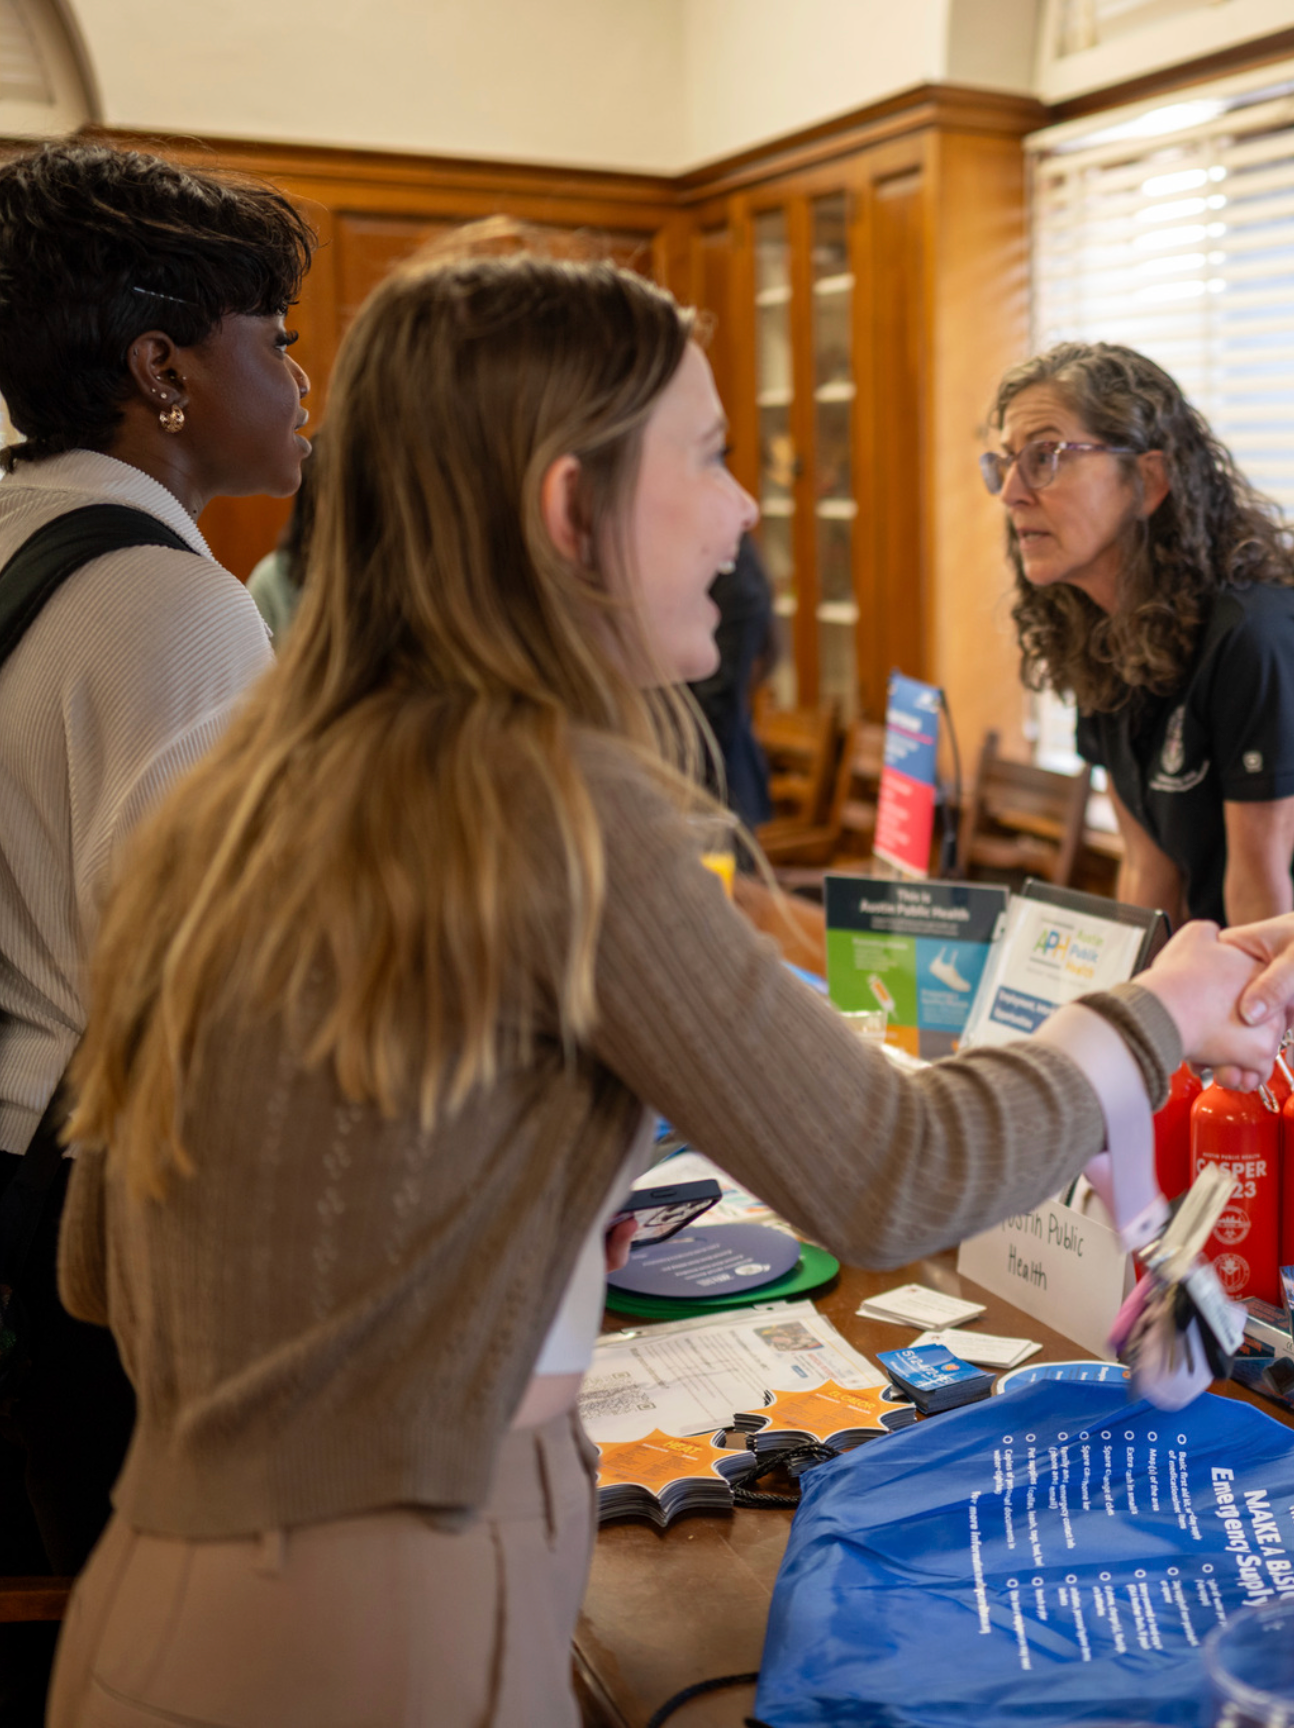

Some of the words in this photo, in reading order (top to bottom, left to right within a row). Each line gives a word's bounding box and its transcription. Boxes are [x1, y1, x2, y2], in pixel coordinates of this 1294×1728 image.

[859, 899, 896, 915] Austin
[897, 903, 930, 919] Public
[932, 907, 971, 922] Health
[1230, 1180, 1257, 1199] 23
[1001, 1213, 1044, 1240] ustin
[1047, 1212, 1085, 1258] Public
[1007, 1243, 1048, 1291] Health
[662, 1440, 703, 1455] HEAT
[1027, 1447, 1036, 1459] Pet
[1081, 1445, 1091, 1467] Spare
[1103, 1445, 1113, 1468] Spare
[1126, 1446, 1135, 1468] Extra
[1168, 1449, 1177, 1460] of
[1003, 1449, 1014, 1471] Copies
[1178, 1451, 1187, 1471] Basic
[1149, 1476, 1159, 1485] of
[1180, 1471, 1188, 1487] first
[1150, 1484, 1159, 1497] the
[969, 1505, 979, 1530] more
[1211, 1466, 1252, 1553] Emergency
[1243, 1489, 1282, 1545] MAKE
[1259, 1546, 1286, 1557] A
